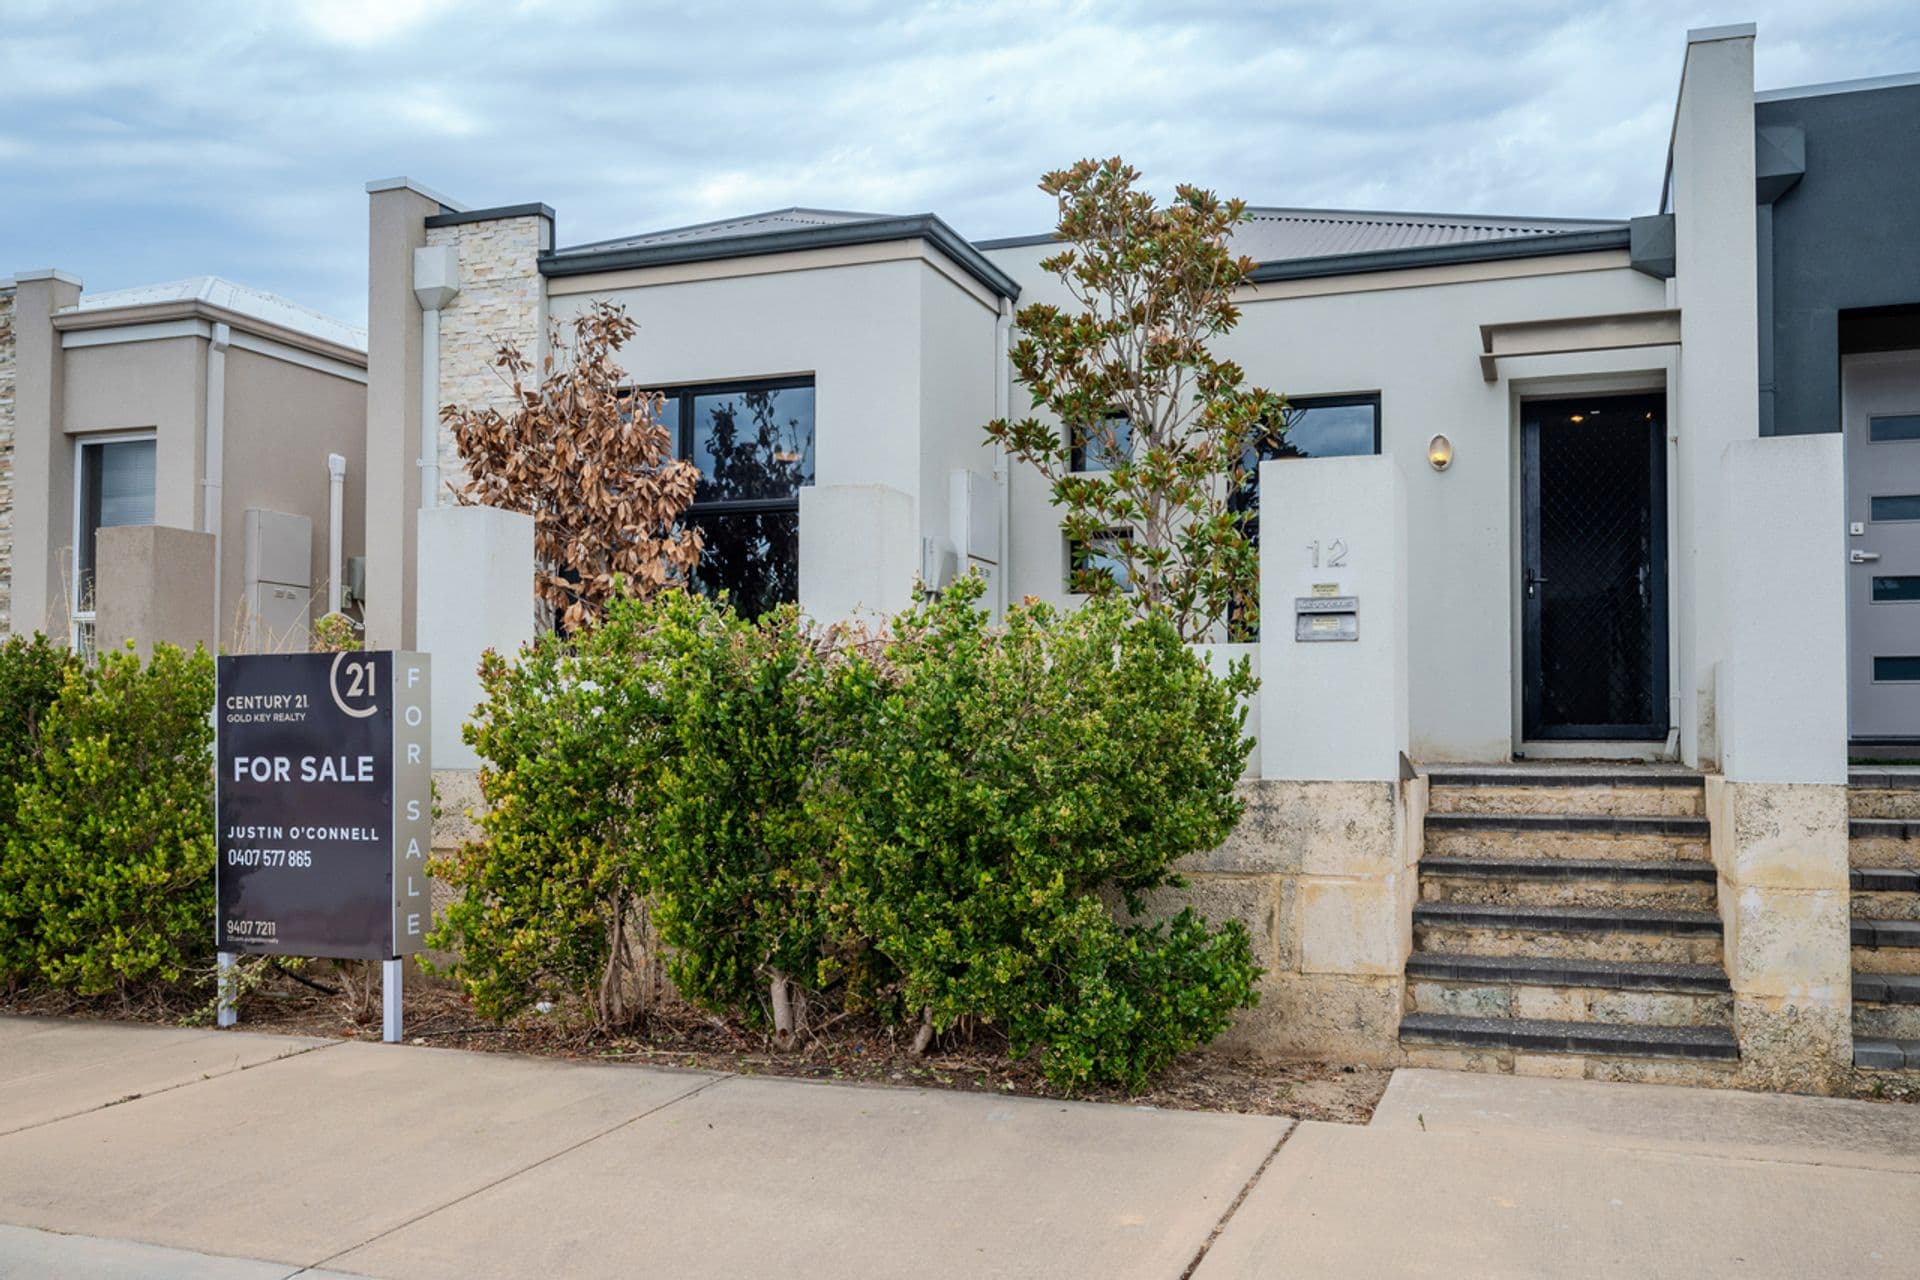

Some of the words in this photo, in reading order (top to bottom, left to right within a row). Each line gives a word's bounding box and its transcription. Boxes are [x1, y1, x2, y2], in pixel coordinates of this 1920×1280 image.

[1305, 538, 1348, 568] 12
[226, 695, 291, 710] CENTURY
[295, 694, 308, 709] 21
[226, 713, 252, 723] GOLD
[253, 713, 272, 722] KEY
[272, 712, 306, 722] REALTY
[404, 667, 422, 765] FOR
[233, 756, 291, 782] FOR
[300, 755, 374, 782] SALE
[227, 826, 283, 840] JUSTIN
[289, 827, 380, 841] O'CONNELL
[227, 849, 260, 866] 0407
[262, 850, 285, 867] 577
[287, 850, 312, 868] 865
[405, 799, 421, 936] SALE
[226, 919, 254, 935] 9407
[255, 920, 276, 936] 7211
